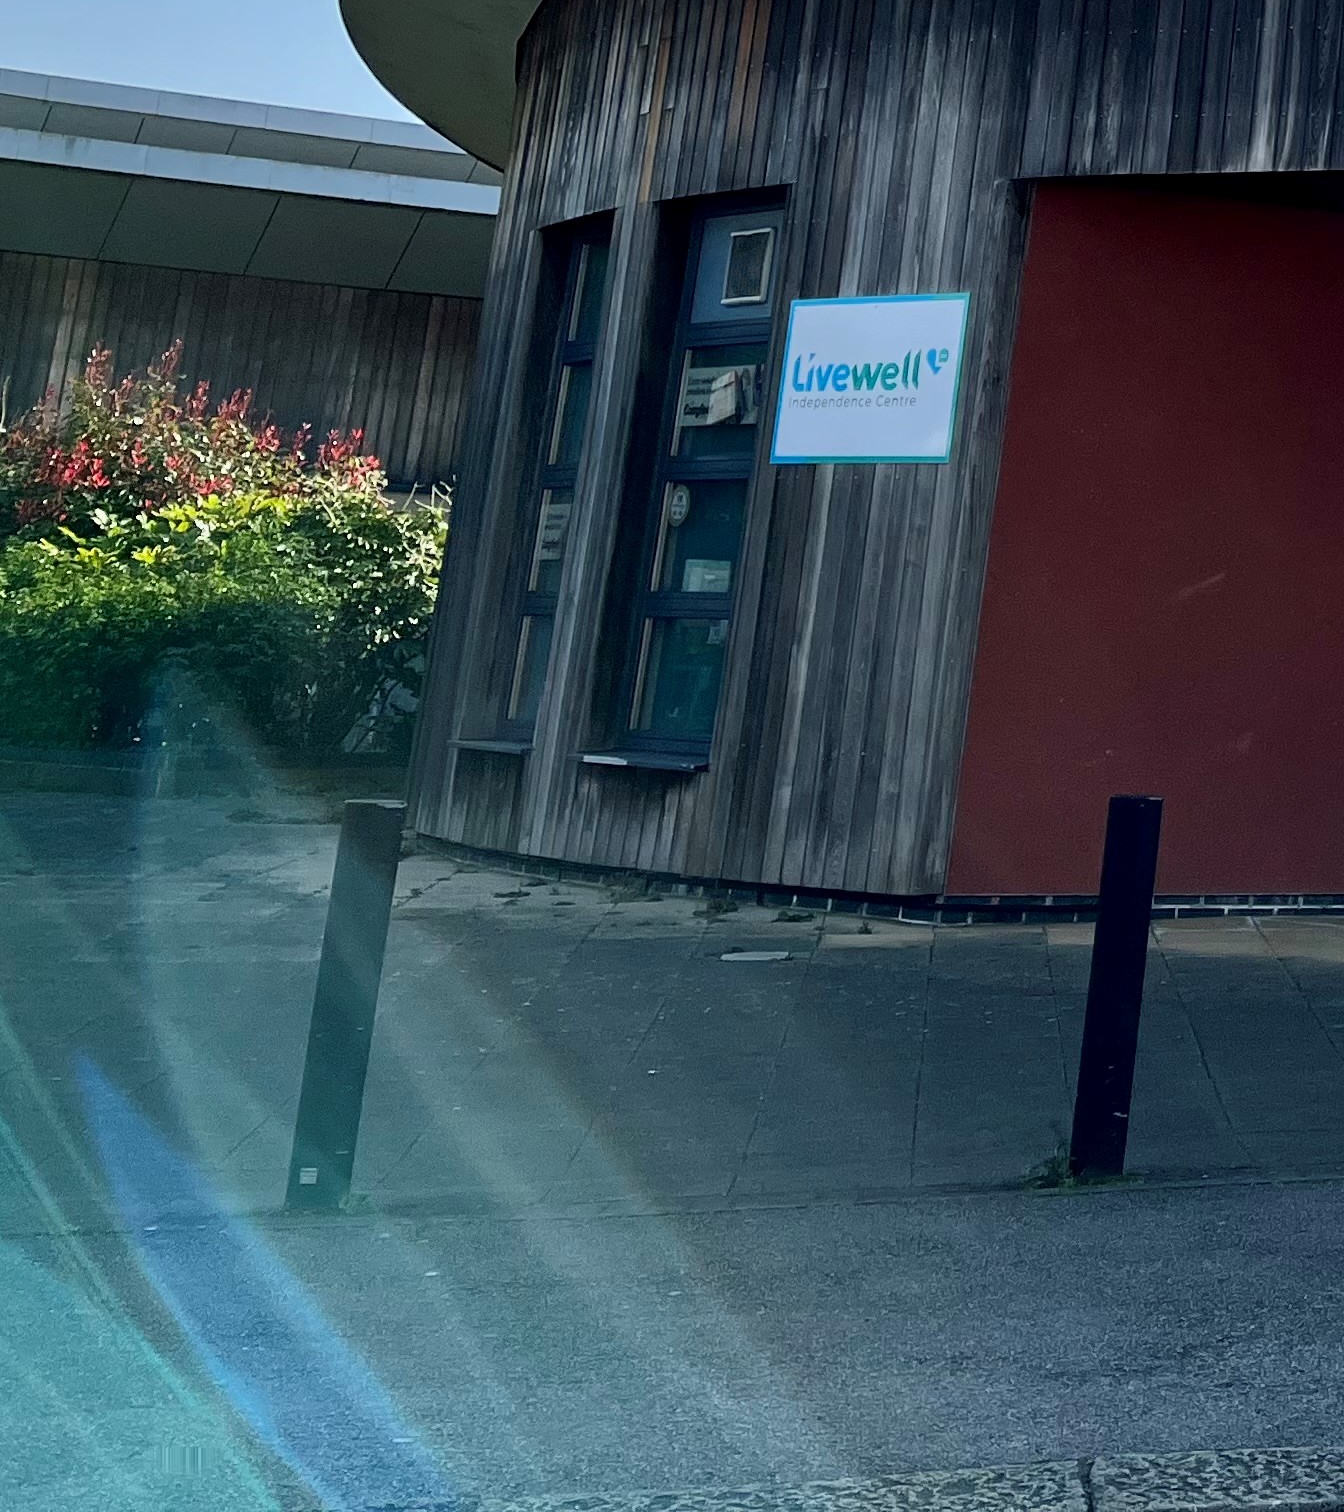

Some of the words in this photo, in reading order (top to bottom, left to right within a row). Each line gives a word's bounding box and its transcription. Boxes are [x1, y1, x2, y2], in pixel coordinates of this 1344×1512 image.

[792, 348, 921, 393] Livewell
[788, 395, 871, 410] Independence
[876, 395, 917, 407] Centre
